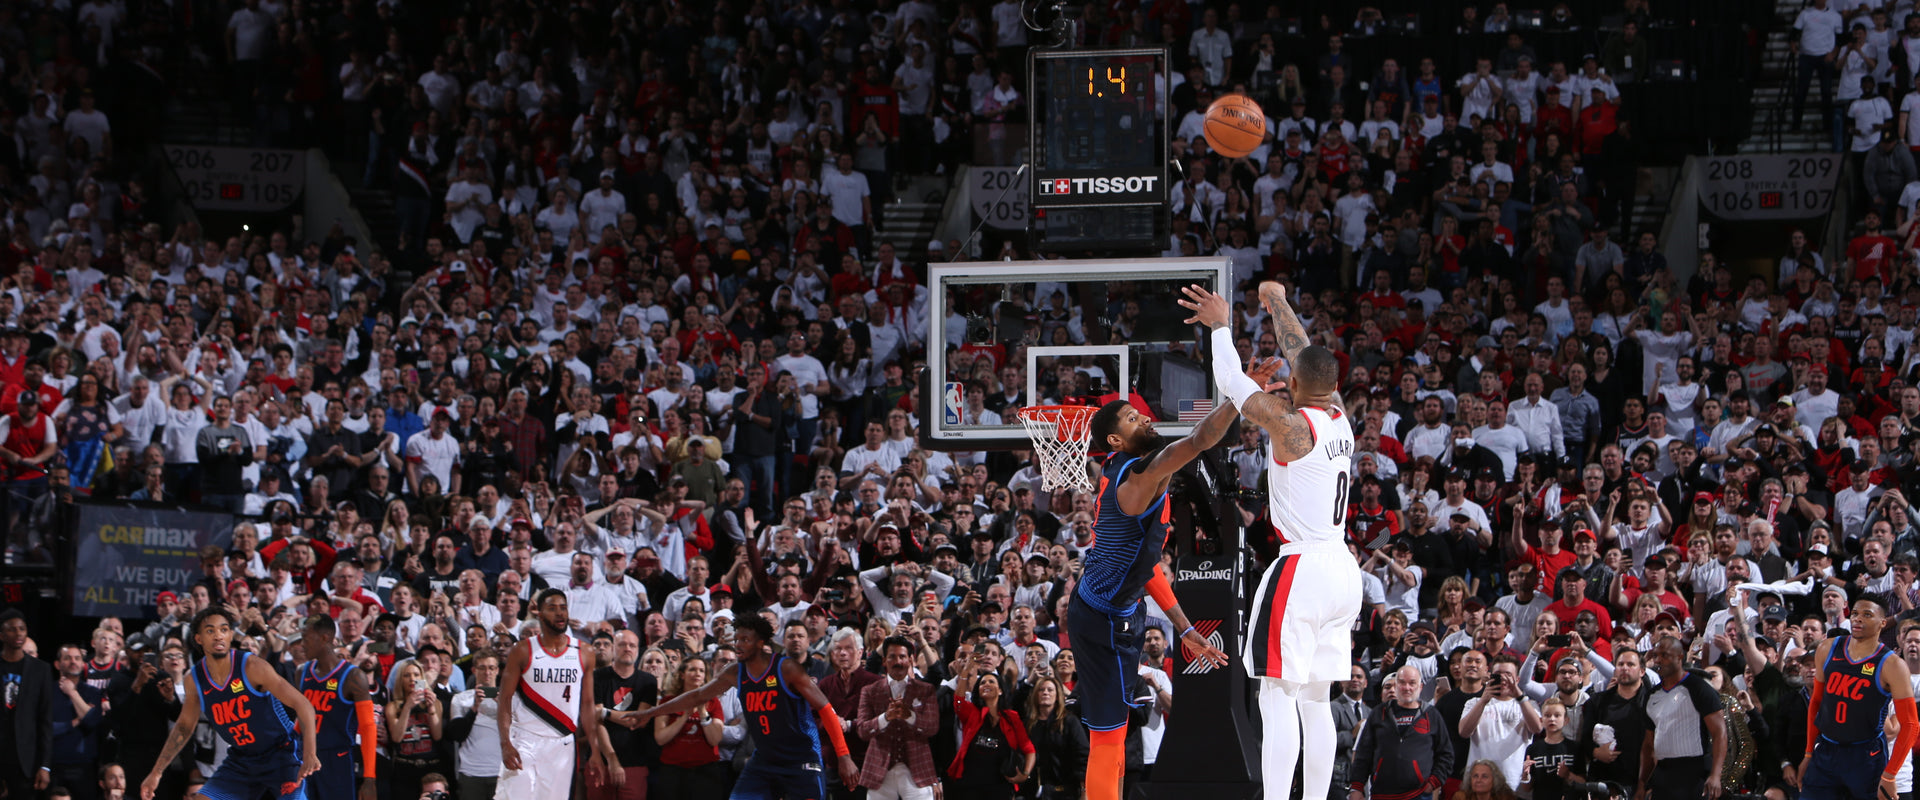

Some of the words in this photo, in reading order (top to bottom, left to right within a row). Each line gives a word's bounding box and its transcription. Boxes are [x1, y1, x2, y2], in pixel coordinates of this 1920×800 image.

[1088, 66, 1126, 97] 1.4
[172, 149, 215, 169] 206
[250, 152, 294, 172] 207
[1788, 158, 1832, 178] 209
[982, 170, 1024, 190] 207
[1709, 160, 1753, 180] 208
[186, 179, 214, 200] 05
[251, 183, 293, 202] 105
[1072, 176, 1158, 194] TISSOT
[1710, 191, 1753, 211] 106
[1761, 192, 1780, 207] EXIT
[1790, 189, 1832, 209] 107
[982, 201, 1024, 220] 105
[1333, 471, 1347, 526] 0
[116, 565, 149, 583] WE
[152, 567, 192, 585] BUY
[1178, 568, 1232, 582] SPALDING
[83, 586, 119, 604] ALL
[533, 667, 578, 683] BLAZERS
[562, 684, 571, 703] 4
[1826, 671, 1871, 701] OKC
[211, 694, 252, 725] OKC
[302, 688, 337, 712] OKC
[745, 690, 778, 712] OKC
[1835, 701, 1848, 724] 0
[228, 723, 256, 746] 23
[759, 714, 771, 735] 9
[1533, 754, 1575, 768] ELITE
